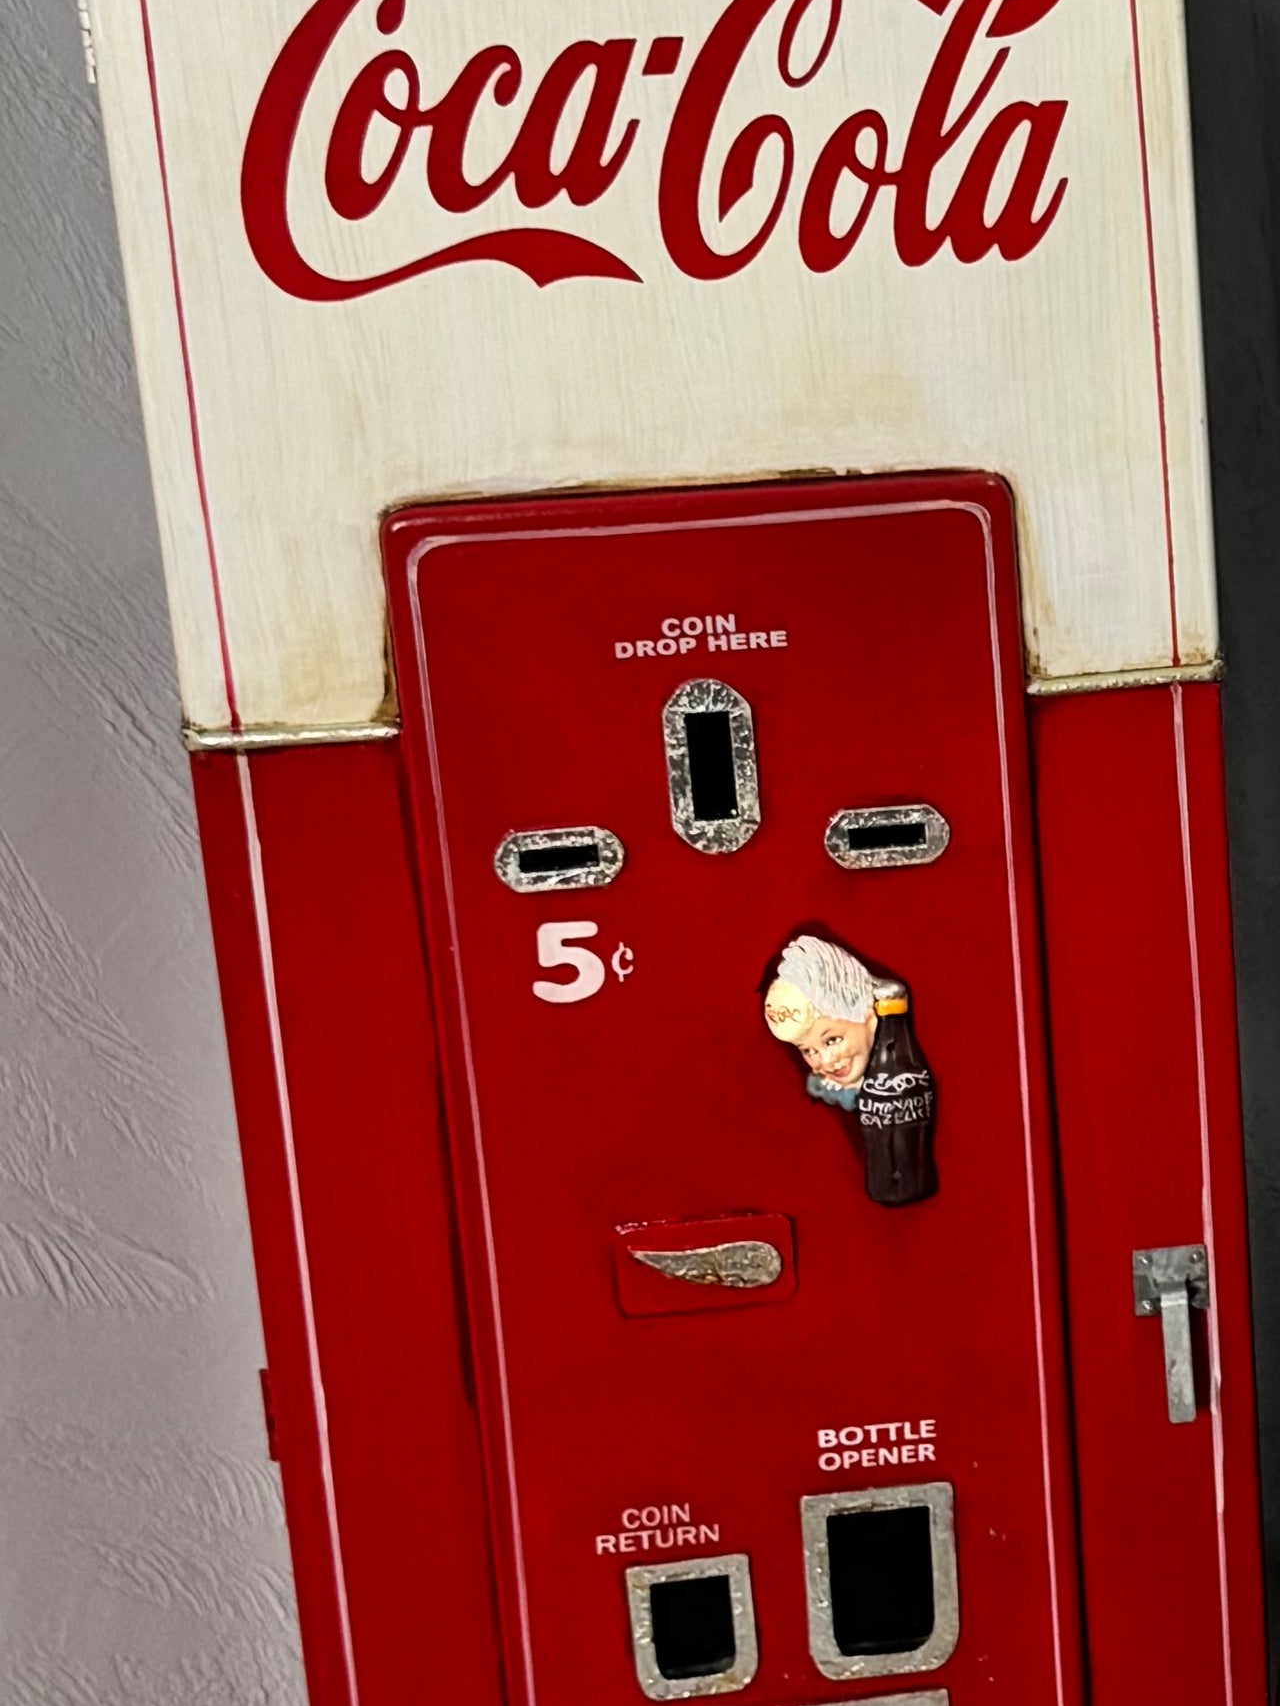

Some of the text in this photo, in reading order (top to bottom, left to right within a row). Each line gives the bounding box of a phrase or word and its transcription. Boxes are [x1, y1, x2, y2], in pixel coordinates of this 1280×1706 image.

[660, 613, 737, 639] COIN
[614, 629, 789, 660] DROP HERE
[531, 920, 635, 1004] 5¢
[816, 1418, 938, 1449] BOTTLE
[817, 1443, 937, 1472] OPENER
[621, 1502, 692, 1530] COIN
[595, 1523, 721, 1556] RETURN
